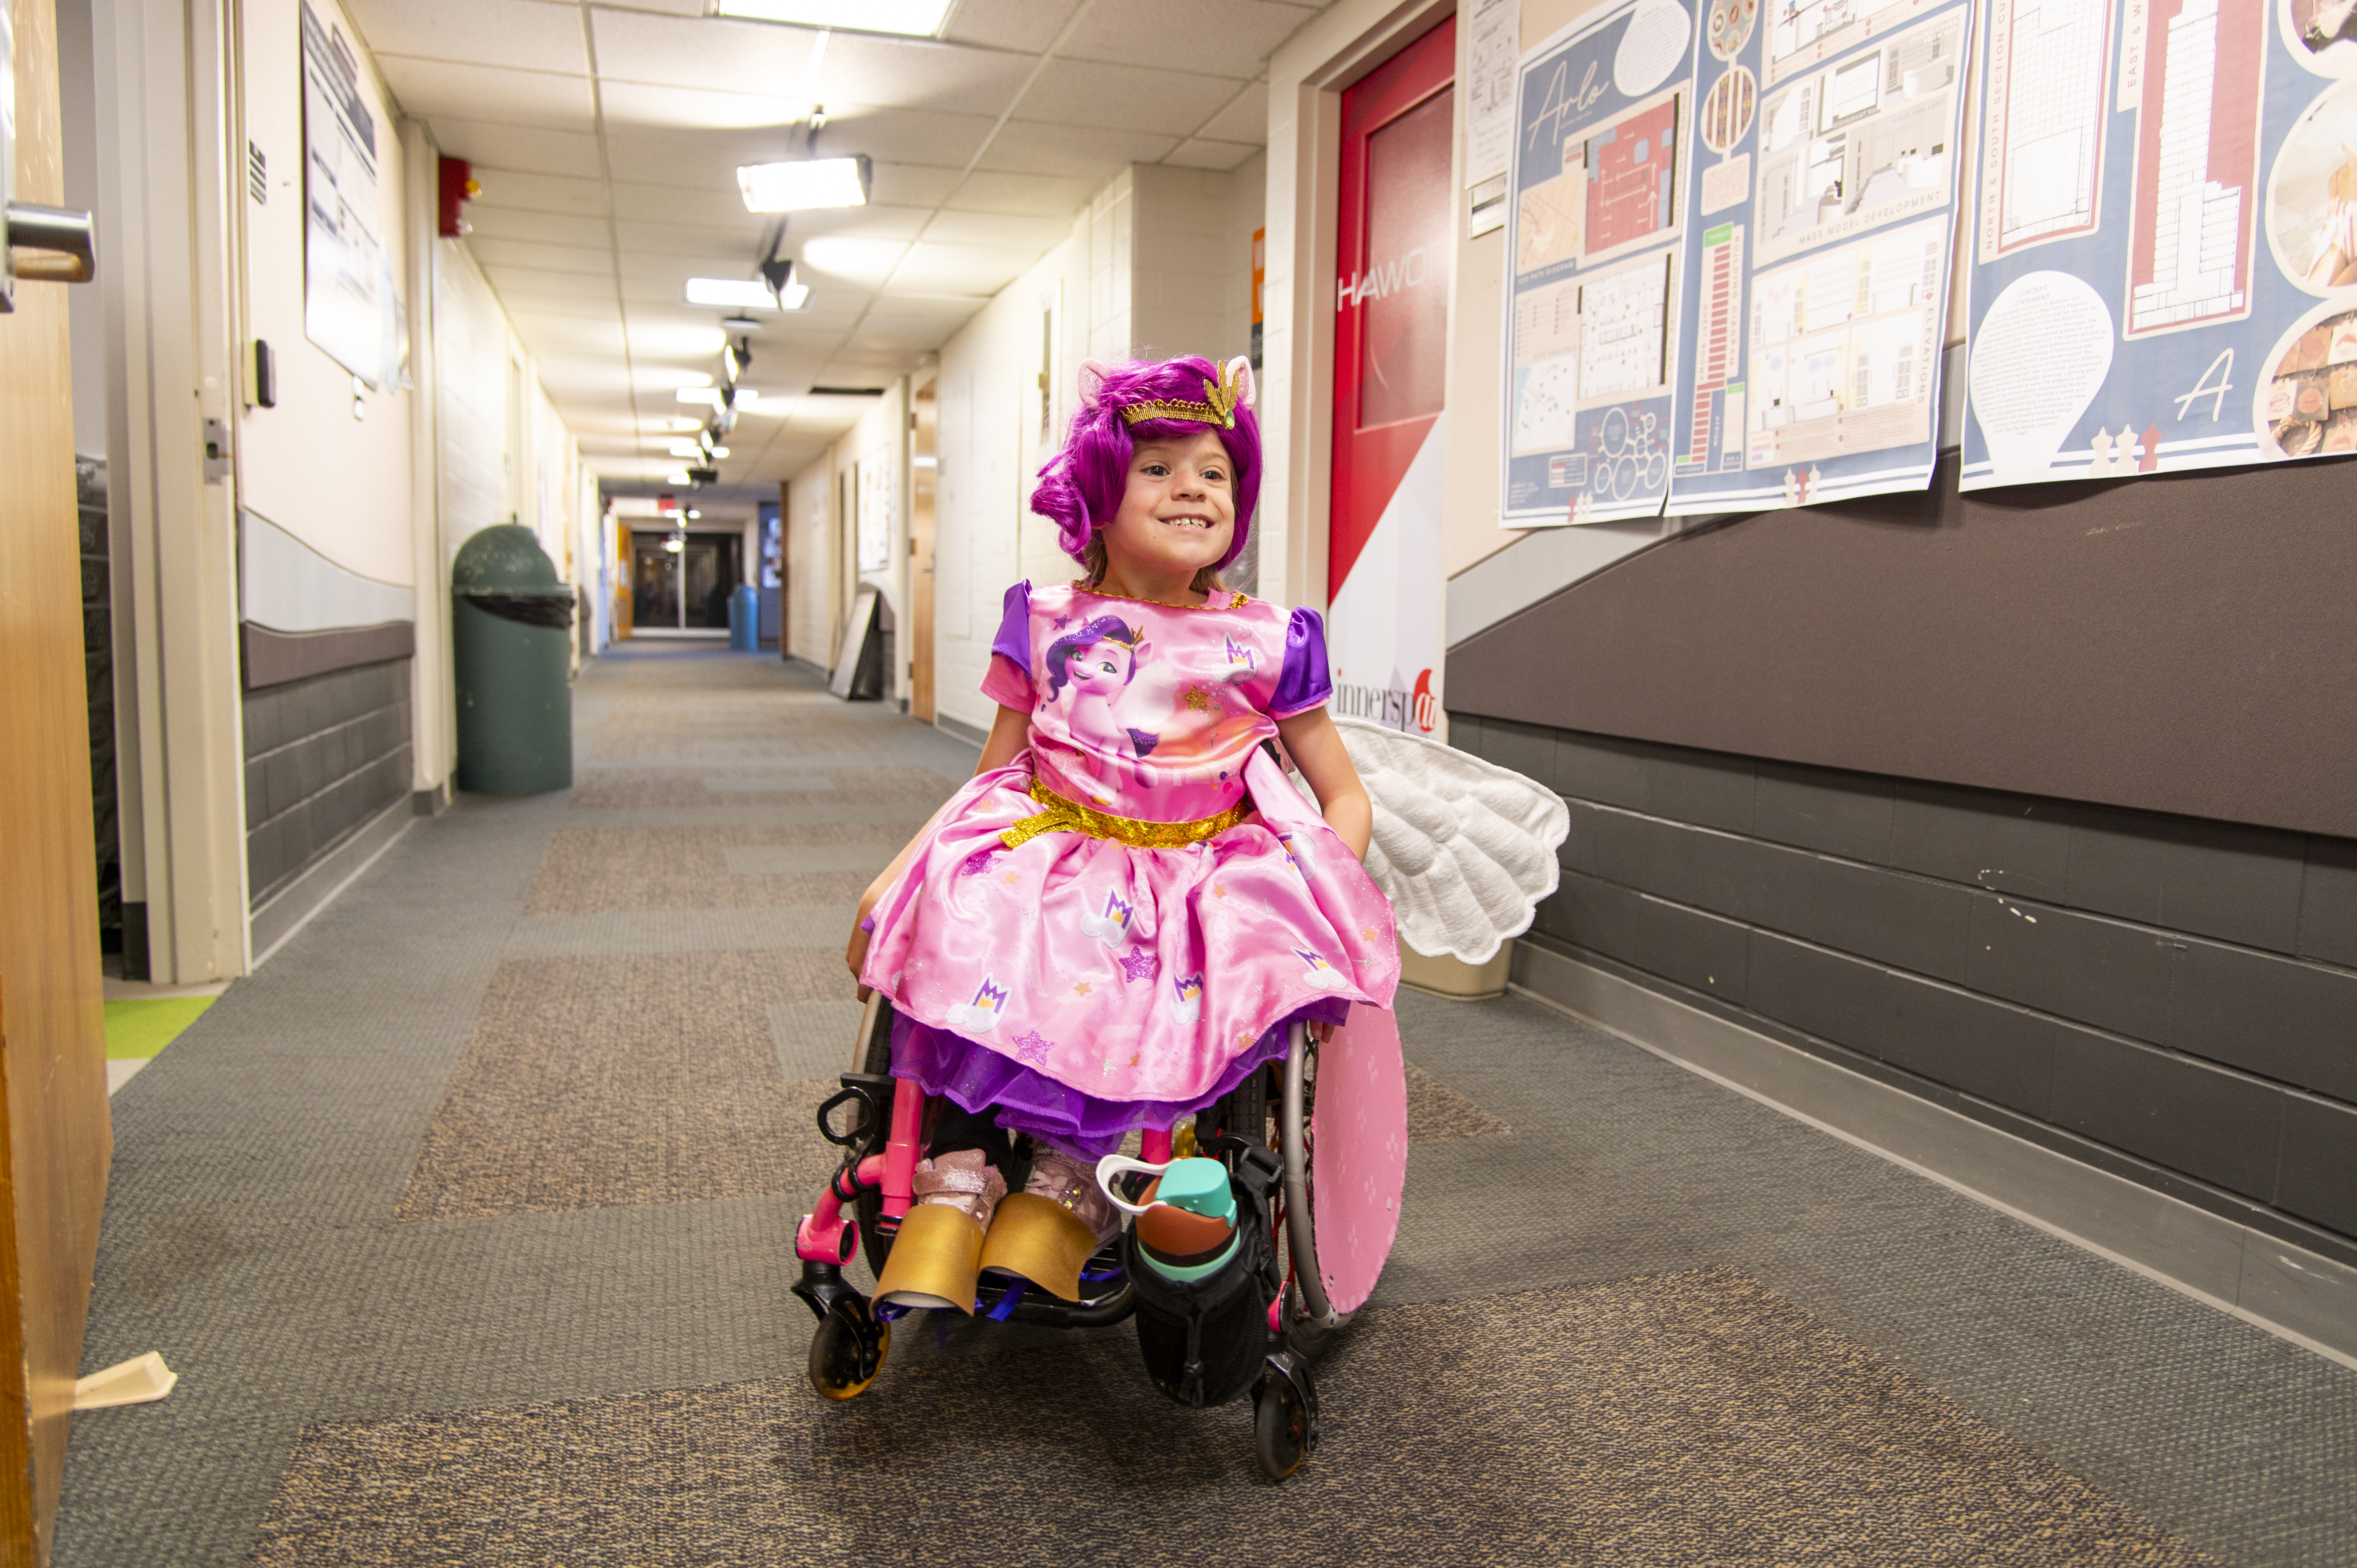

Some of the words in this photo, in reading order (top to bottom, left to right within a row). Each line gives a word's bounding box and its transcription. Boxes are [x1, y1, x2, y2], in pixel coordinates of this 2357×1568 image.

[1910, 29, 1933, 43] SEATED
[1936, 18, 1957, 32] LIVING
[1924, 32, 1941, 44] ROOM
[1944, 26, 1957, 36] BAR
[2128, 46, 2138, 87] EAST
[2133, 0, 2141, 17] W
[1527, 60, 1609, 151] Arlo
[1892, 113, 1909, 123] RIGHT
[1912, 107, 1925, 116] SIDE
[1928, 99, 1946, 110] LOBBY
[1986, 195, 1995, 249] NORTH
[1994, 33, 2003, 105] SECTION
[1799, 230, 1822, 244] MASS
[1828, 219, 1860, 235] MODEL
[1864, 191, 1941, 222] DEVELOPMENT
[2015, 294, 2050, 307] STATEMENT
[2017, 285, 2047, 298] CONCEPT
[1728, 306, 1737, 365] DIAGRAM
[1918, 308, 1934, 403] ELEVATIONS
[2069, 360, 2102, 369] personalized
[2174, 348, 2234, 421] A
